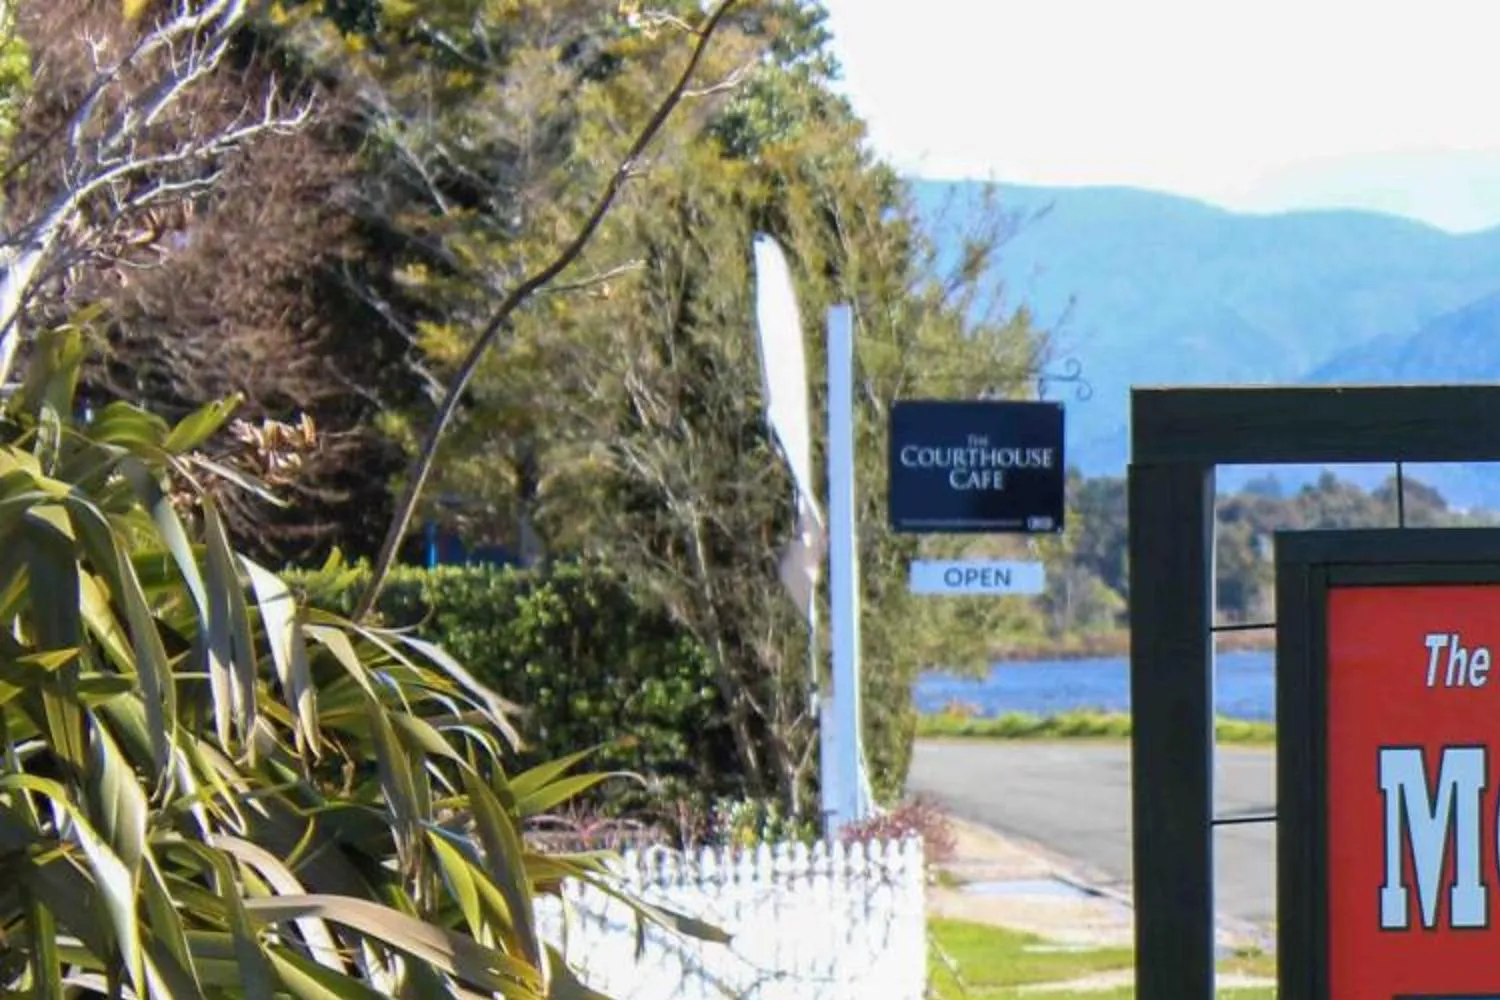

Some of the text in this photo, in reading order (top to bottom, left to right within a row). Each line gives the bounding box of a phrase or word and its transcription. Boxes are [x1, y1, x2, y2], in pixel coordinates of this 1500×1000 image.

[900, 446, 1053, 468] COURTHOUSE
[950, 469, 1004, 490] CAFE
[943, 567, 1012, 588] OPEN
[1424, 632, 1490, 688] The
